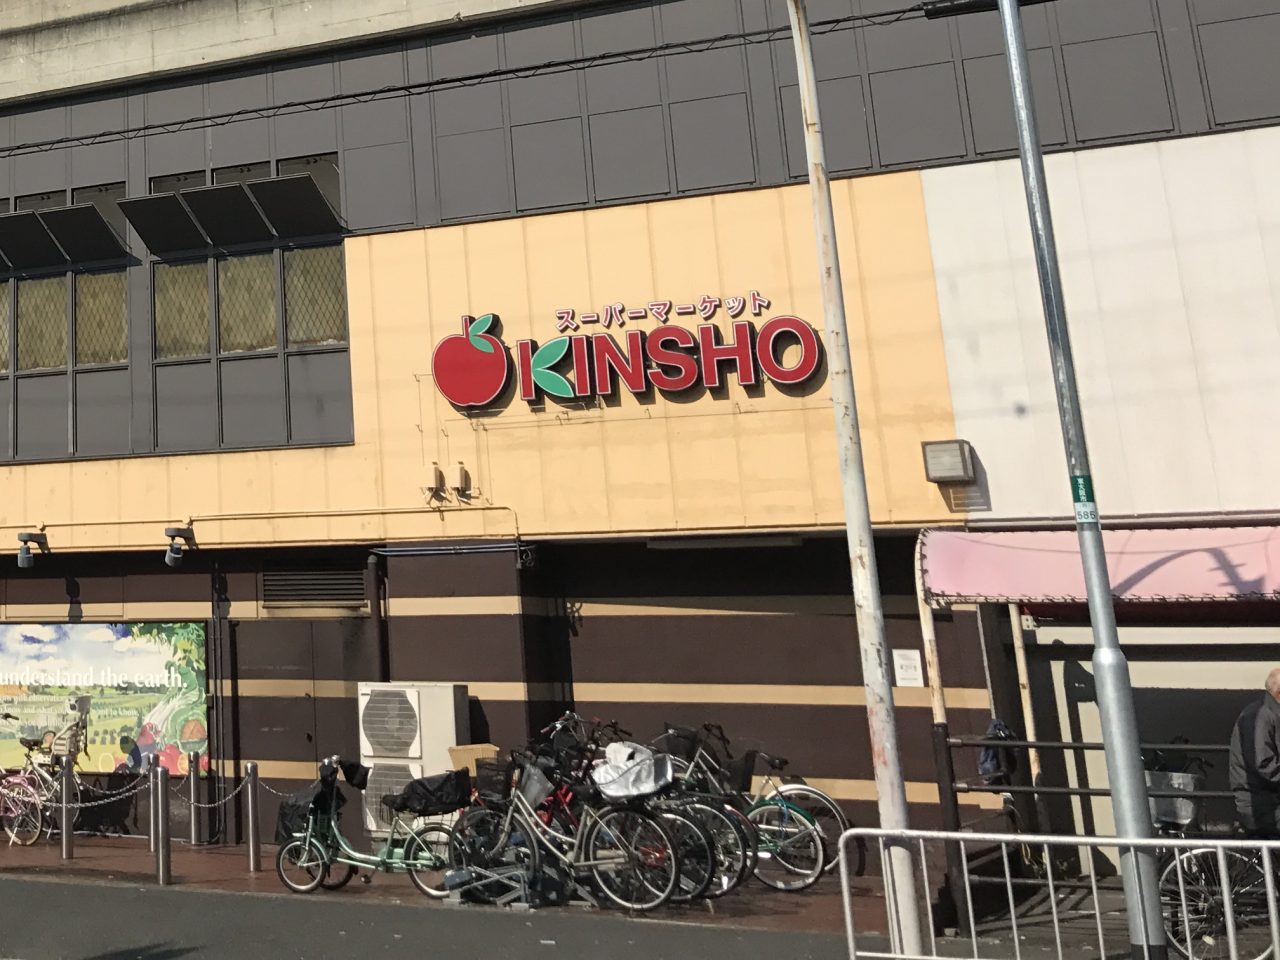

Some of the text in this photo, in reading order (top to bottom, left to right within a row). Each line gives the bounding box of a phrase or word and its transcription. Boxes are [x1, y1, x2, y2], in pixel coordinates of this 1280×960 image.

[556, 291, 770, 331] スーパーマーケット
[519, 315, 819, 401] KINSHO
[1077, 511, 1096, 520] 585
[101, 666, 129, 688] the
[135, 666, 188, 688] earth.
